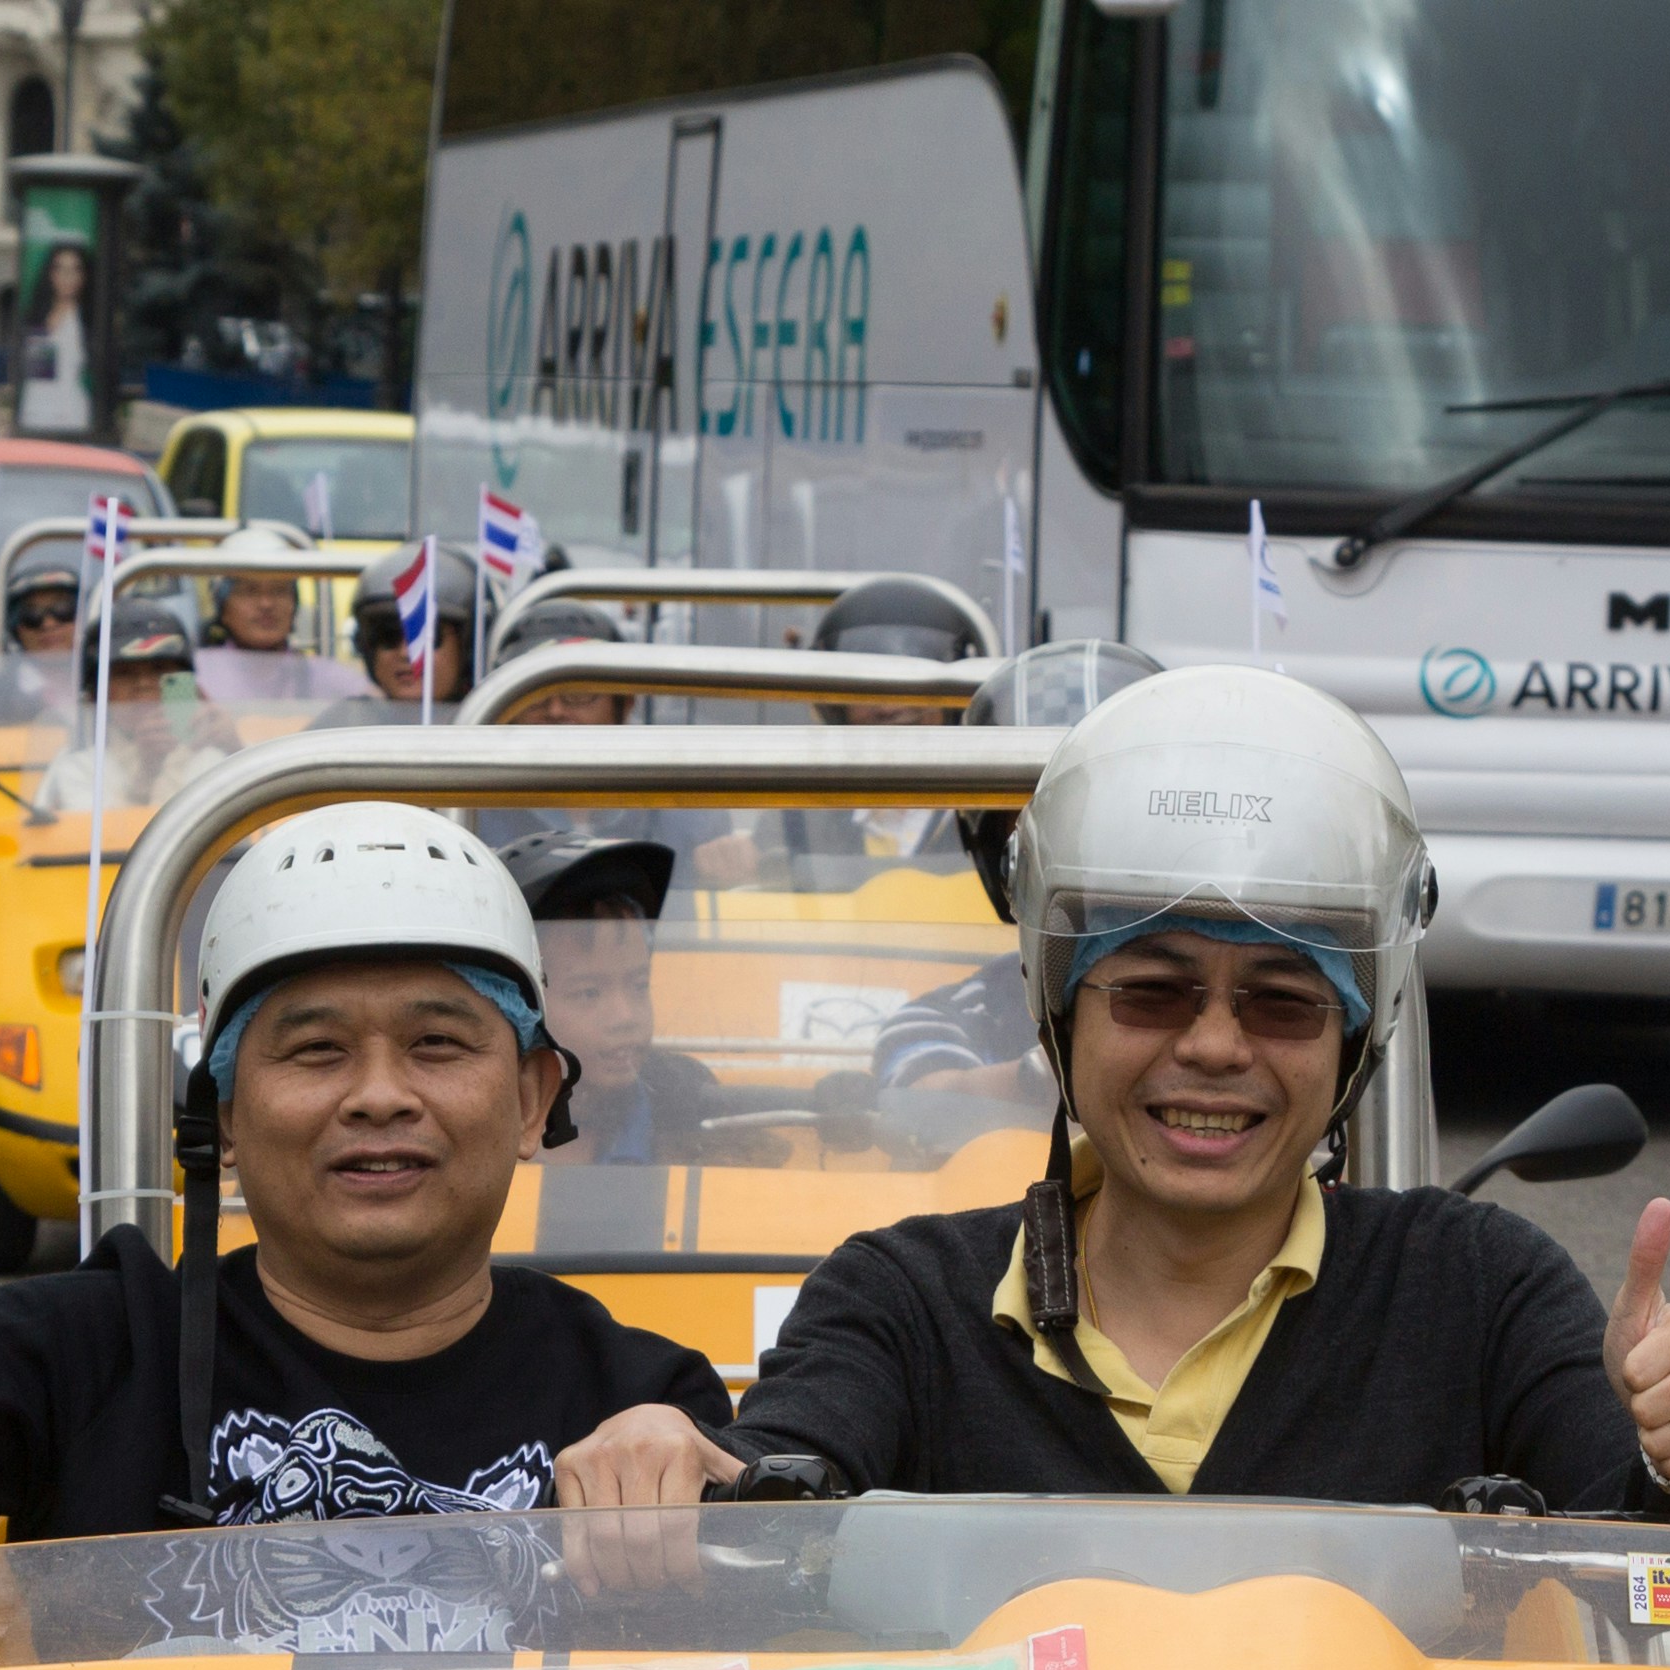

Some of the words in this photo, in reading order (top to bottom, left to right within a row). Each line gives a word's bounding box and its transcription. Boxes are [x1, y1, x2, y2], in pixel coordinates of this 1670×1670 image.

[531, 237, 676, 430] ARRIVA
[696, 224, 870, 445] ESFERA
[1148, 789, 1273, 823] HELIX
[1633, 1576, 1648, 1610] 2864
